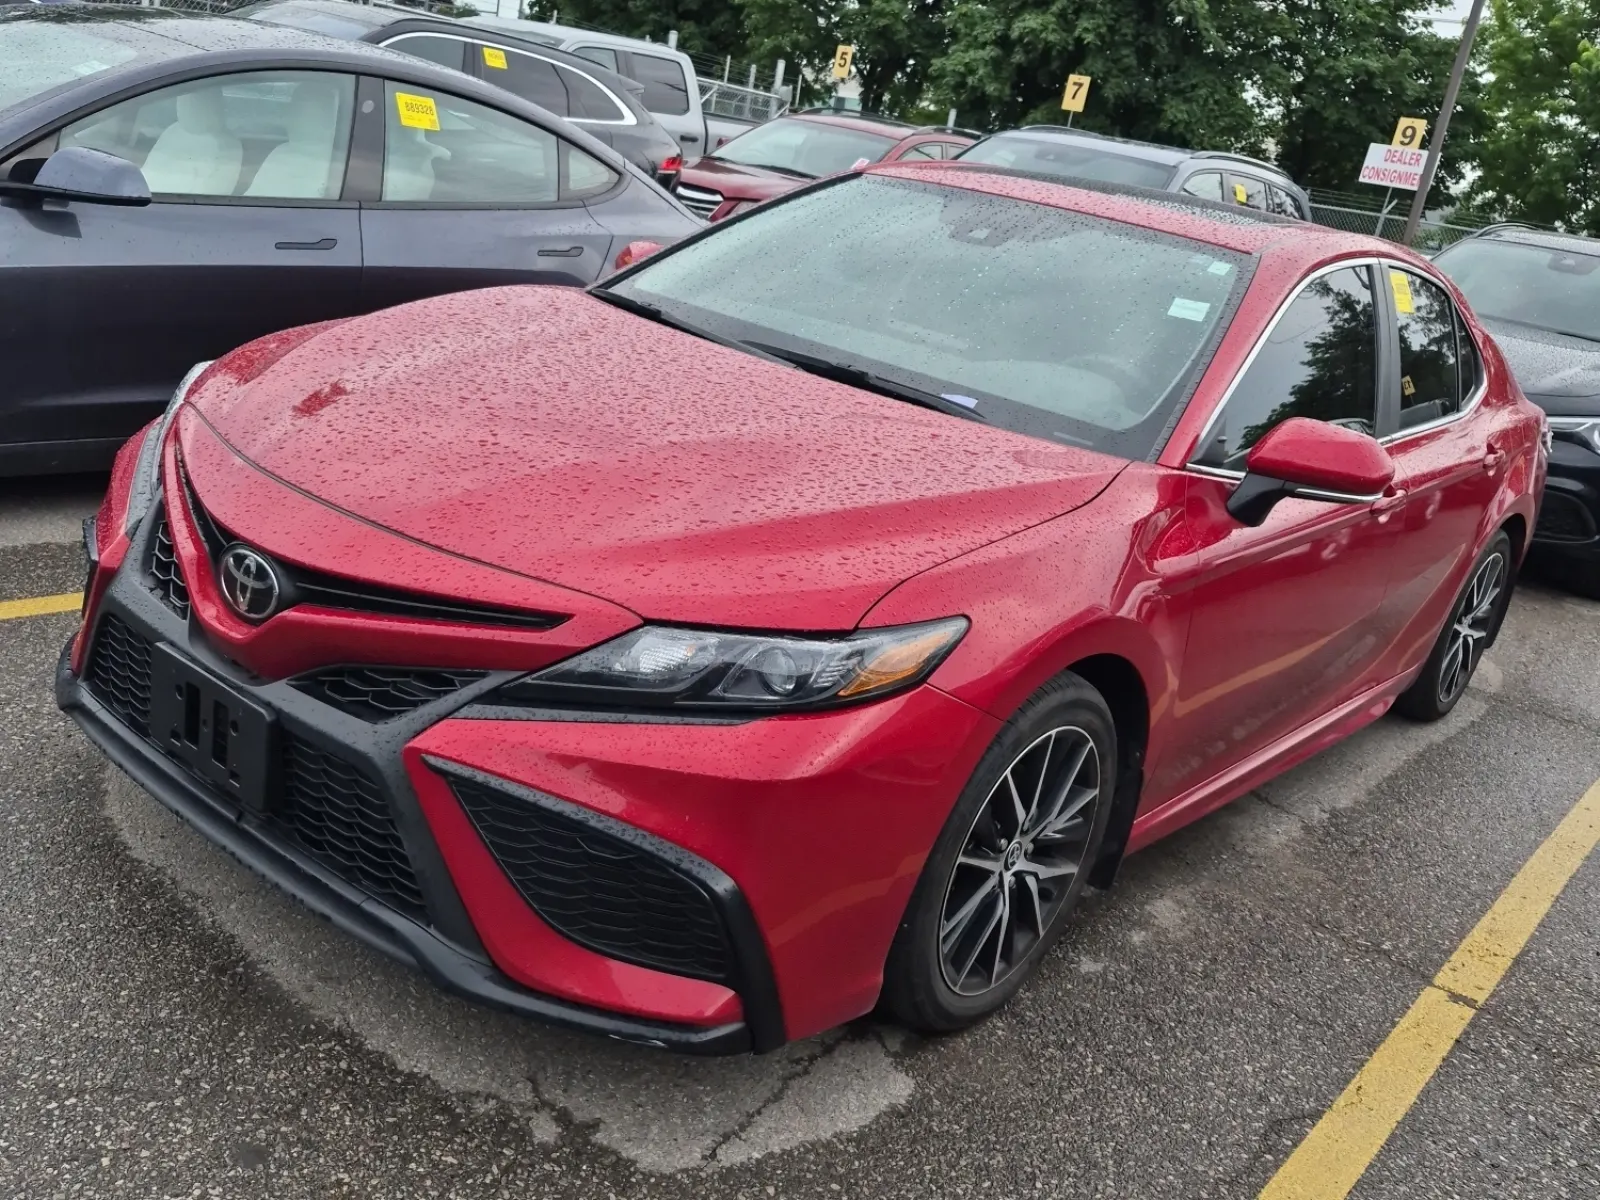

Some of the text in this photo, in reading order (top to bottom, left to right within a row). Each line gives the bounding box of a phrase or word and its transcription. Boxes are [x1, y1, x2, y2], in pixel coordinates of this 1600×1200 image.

[838, 51, 848, 68] 5
[1071, 81, 1084, 100] 7
[1399, 125, 1417, 146] 9
[1383, 148, 1423, 167] DEALER
[1361, 165, 1419, 187] CONSIGNME
